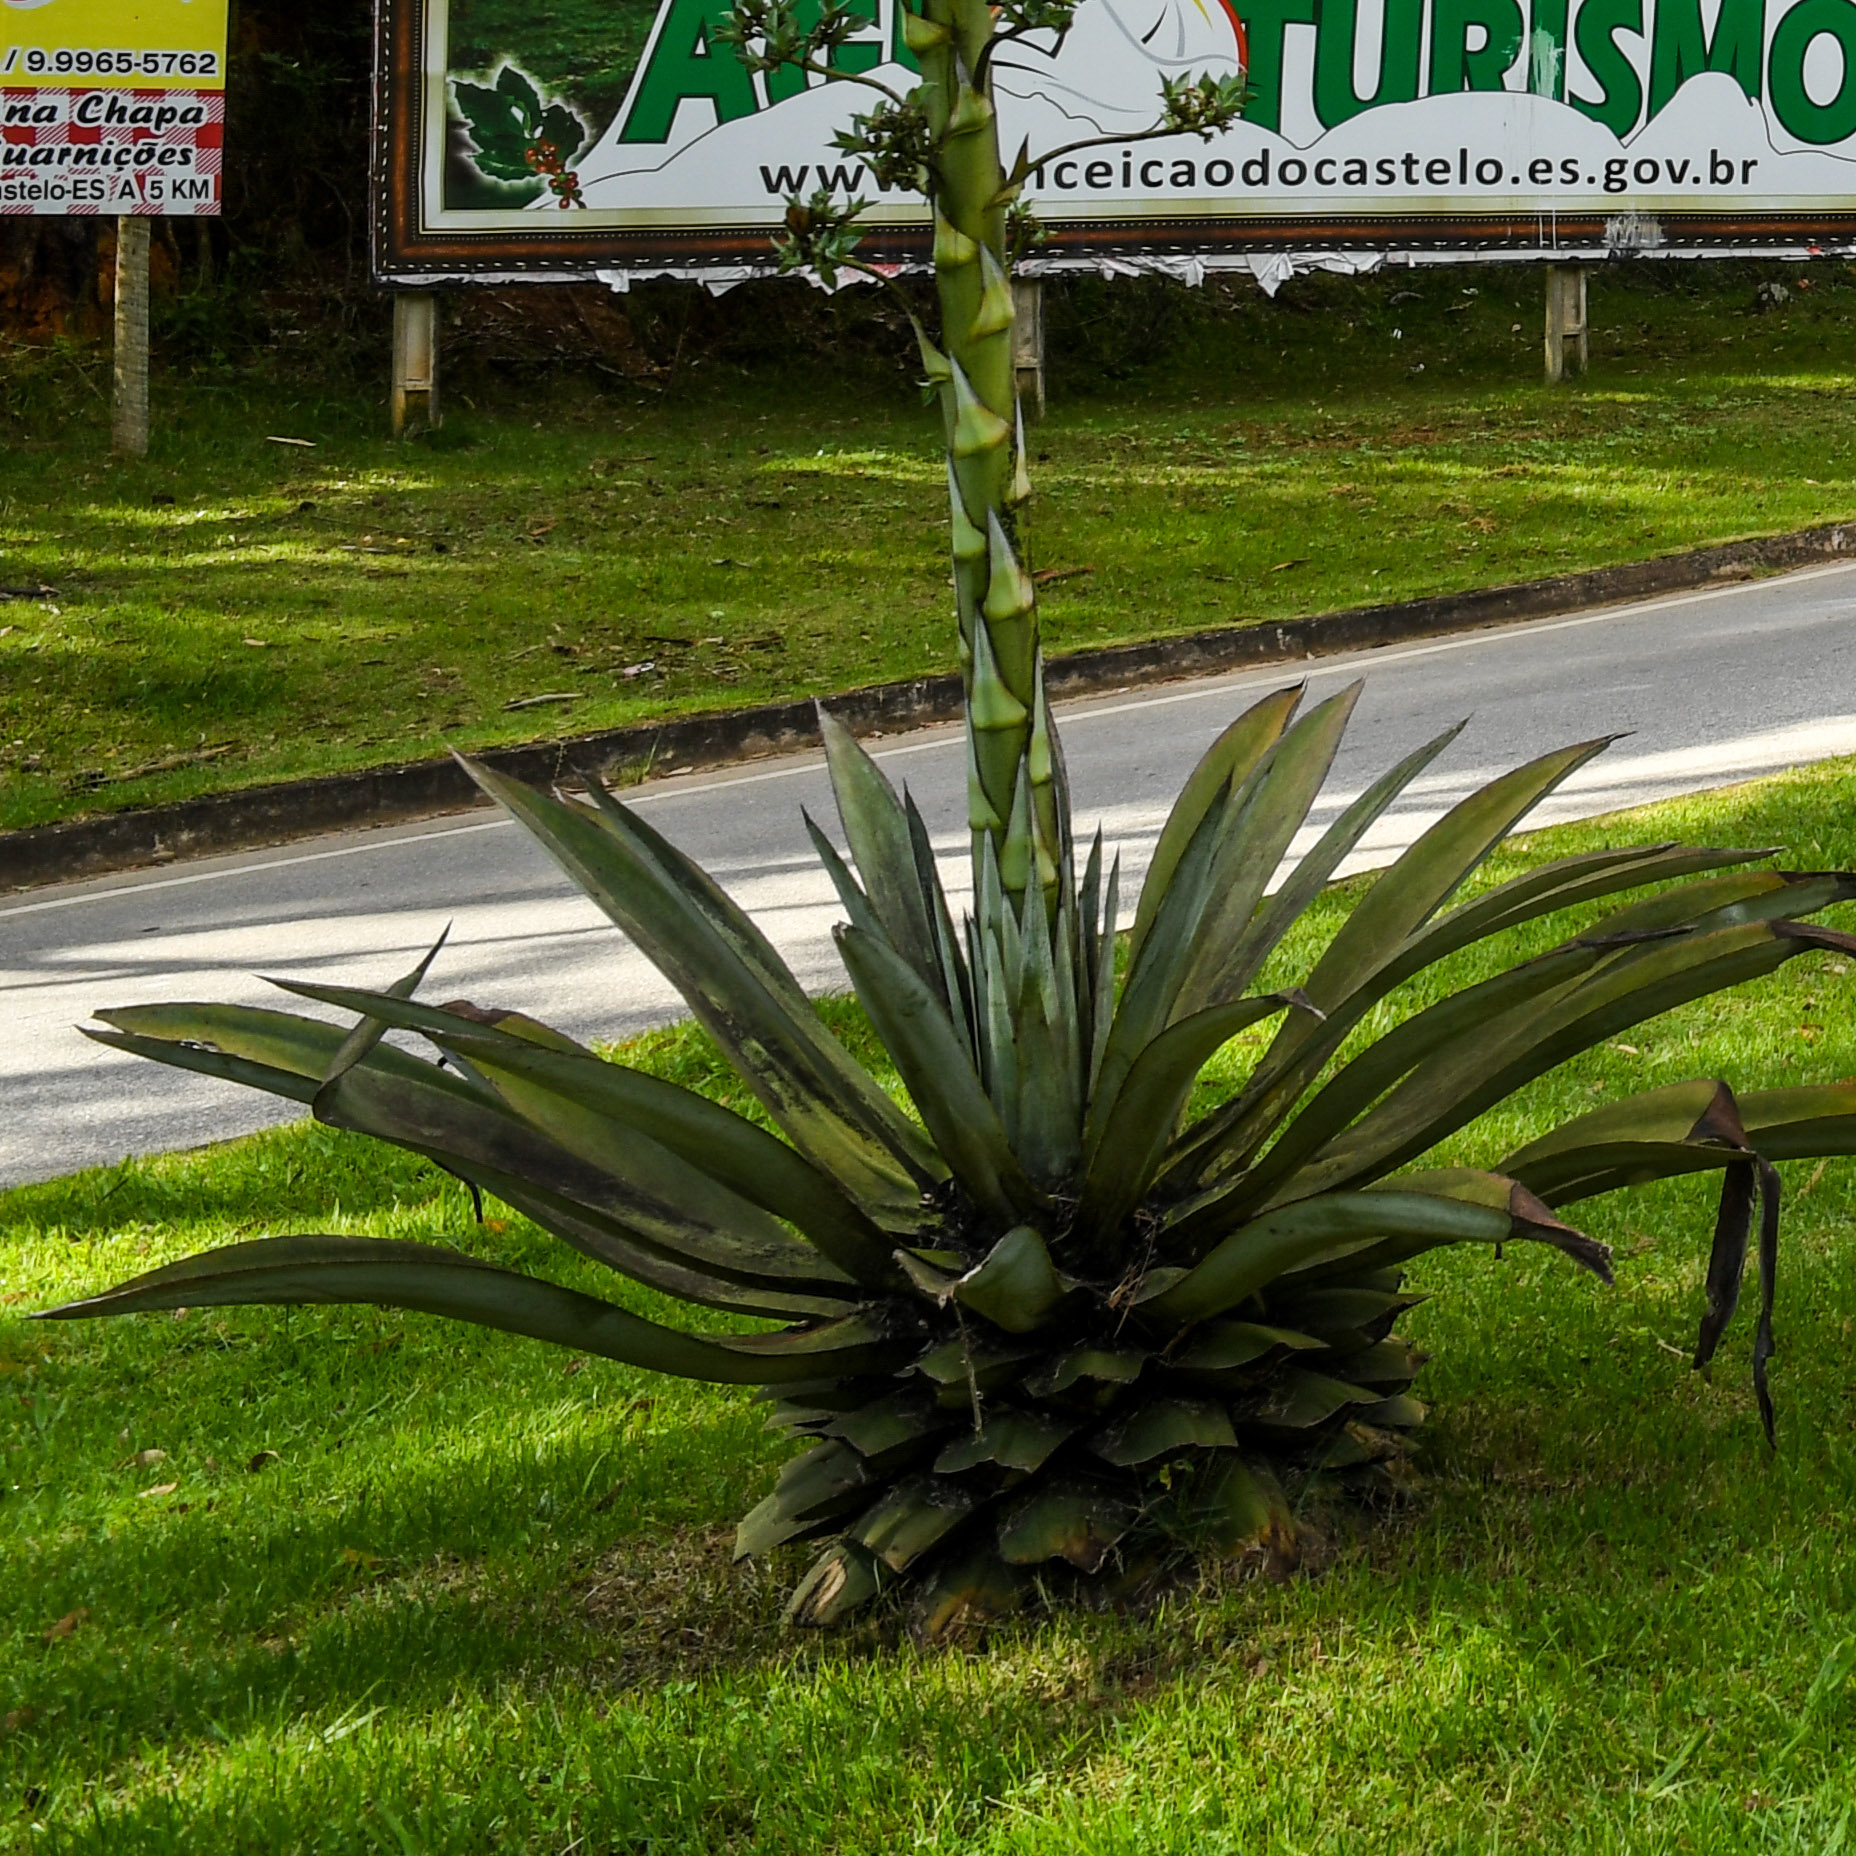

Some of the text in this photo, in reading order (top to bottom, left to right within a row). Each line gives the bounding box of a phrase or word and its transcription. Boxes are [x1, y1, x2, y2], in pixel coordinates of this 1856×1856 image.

[26, 50, 217, 75] 9.9965-5762
[4, 94, 205, 133] na Chapa
[0, 140, 194, 173] uarnições
[118, 178, 137, 200] A
[150, 179, 164, 199] 5
[171, 178, 210, 200] KM
